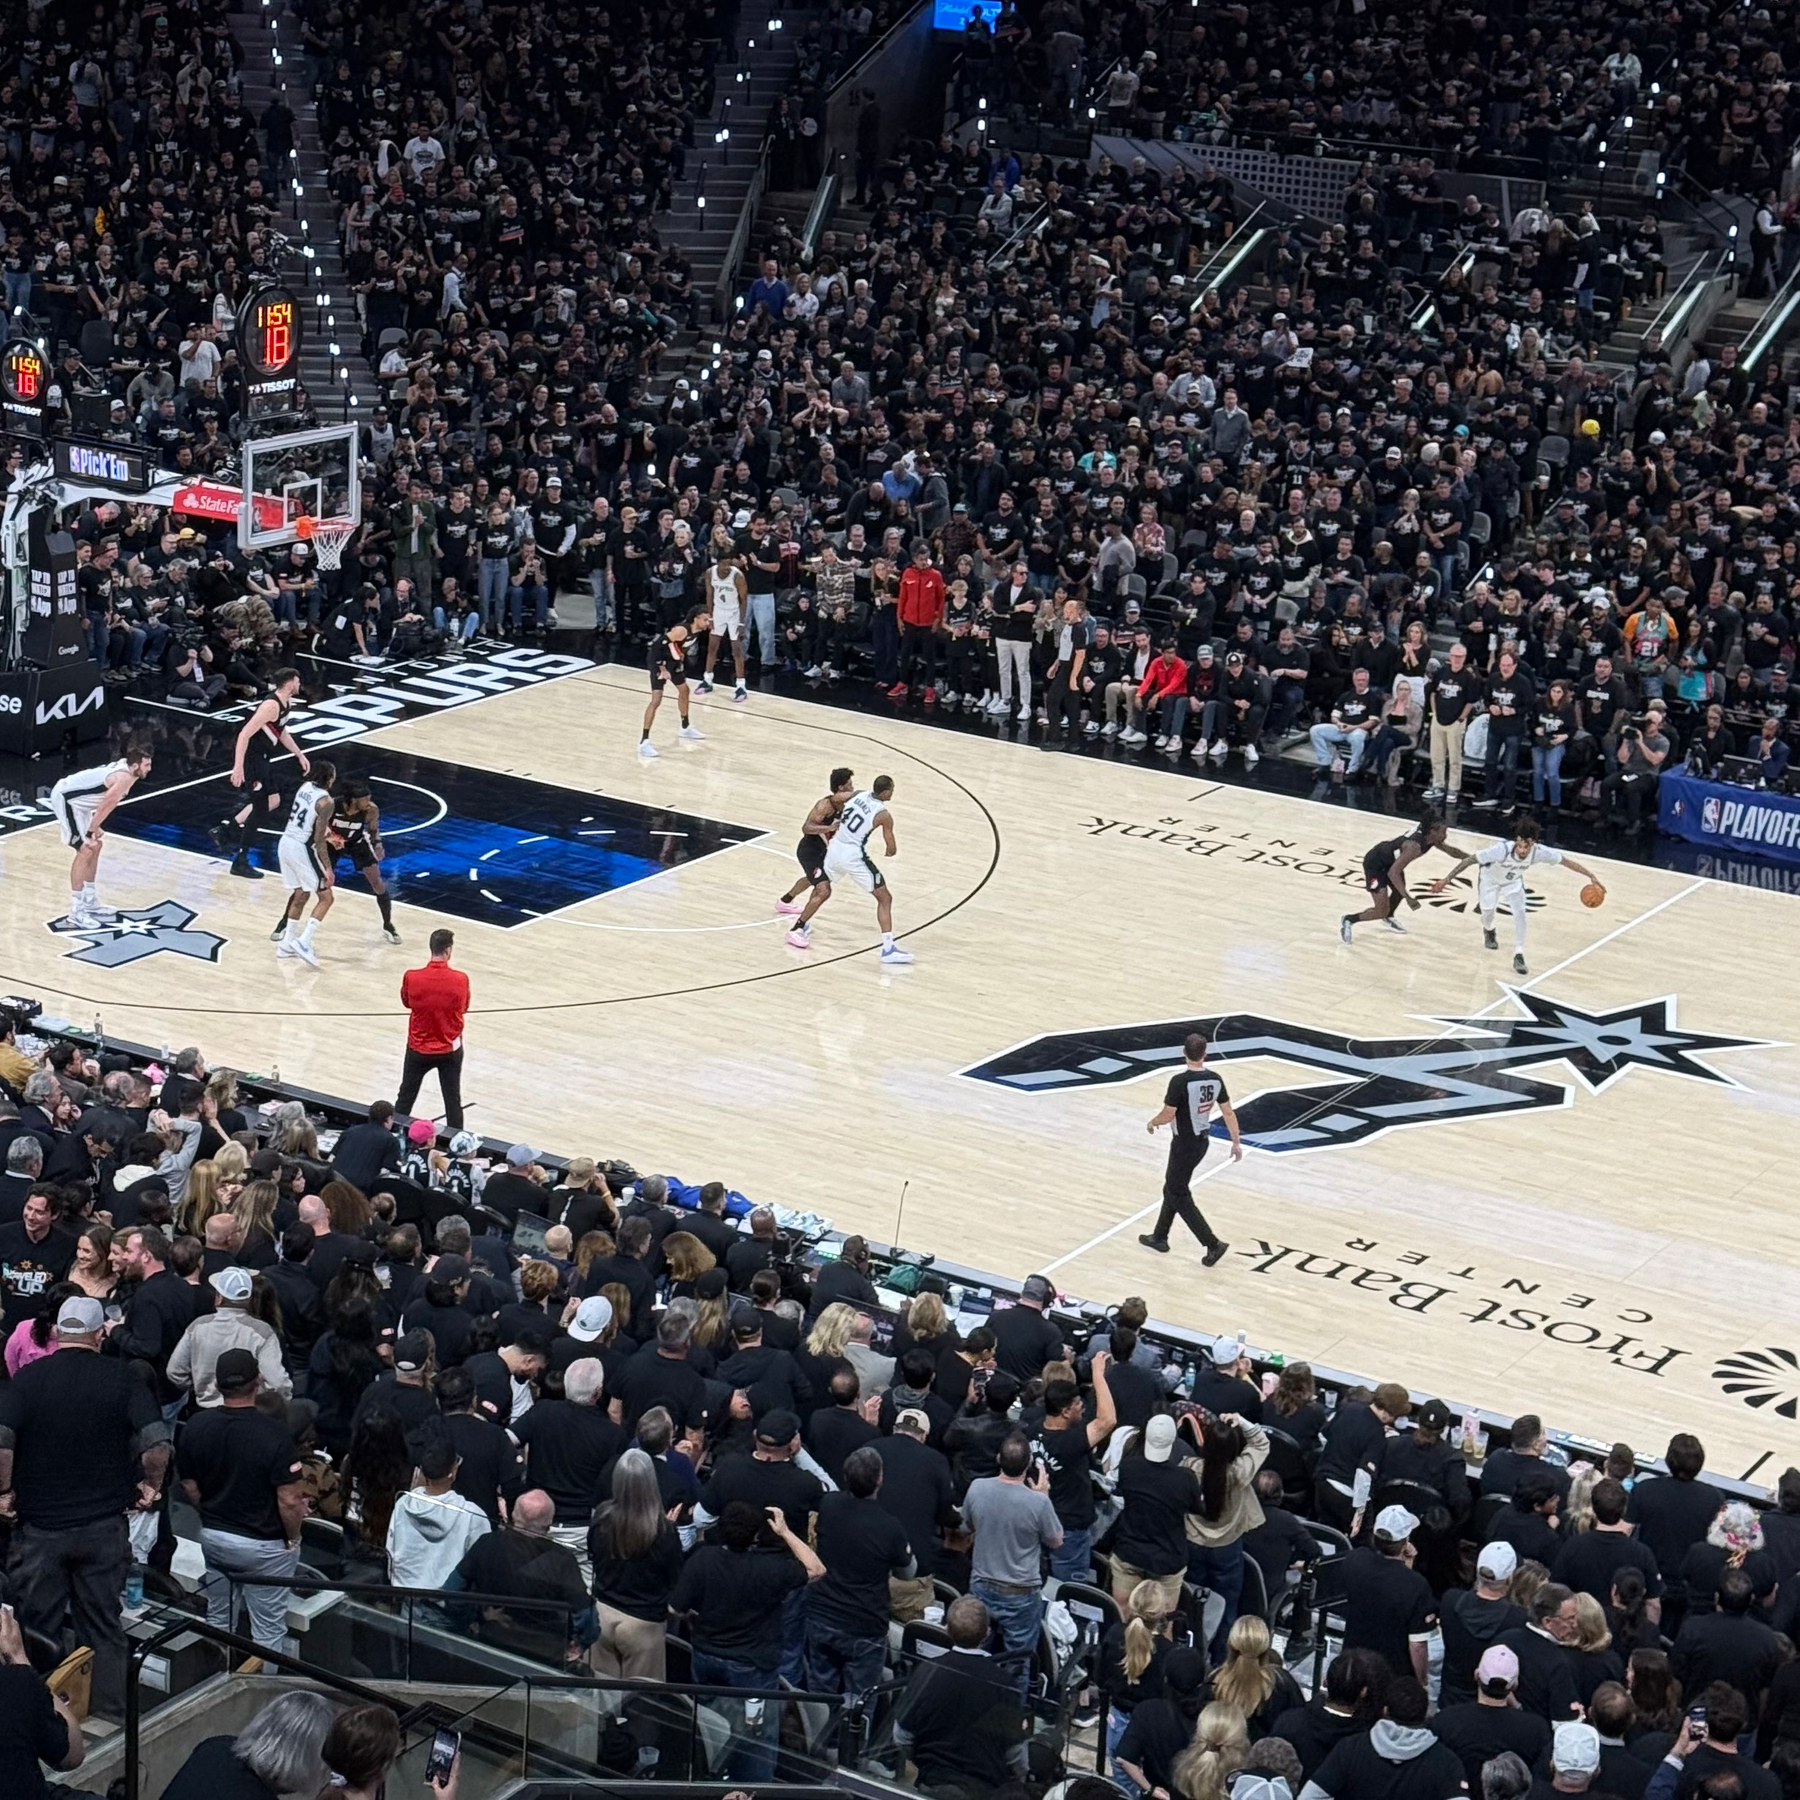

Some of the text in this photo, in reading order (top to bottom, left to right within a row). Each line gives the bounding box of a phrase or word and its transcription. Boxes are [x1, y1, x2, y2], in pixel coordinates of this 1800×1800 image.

[266, 326, 288, 364] 18
[261, 378, 296, 393] TISSOT
[13, 403, 42, 417] TISSOT
[80, 448, 128, 482] Pick'Em
[198, 495, 226, 513] State
[58, 644, 79, 656] Google
[1641, 641, 1658, 657] 21
[284, 649, 597, 741] SPURS
[841, 807, 864, 833] 40
[1718, 800, 1800, 849] PLAYOFF
[1078, 815, 1236, 857] Bank
[1199, 1085, 1214, 1103] 36
[1345, 1237, 1654, 1324] CENTER
[1234, 1238, 1693, 1378] Frost Bank
